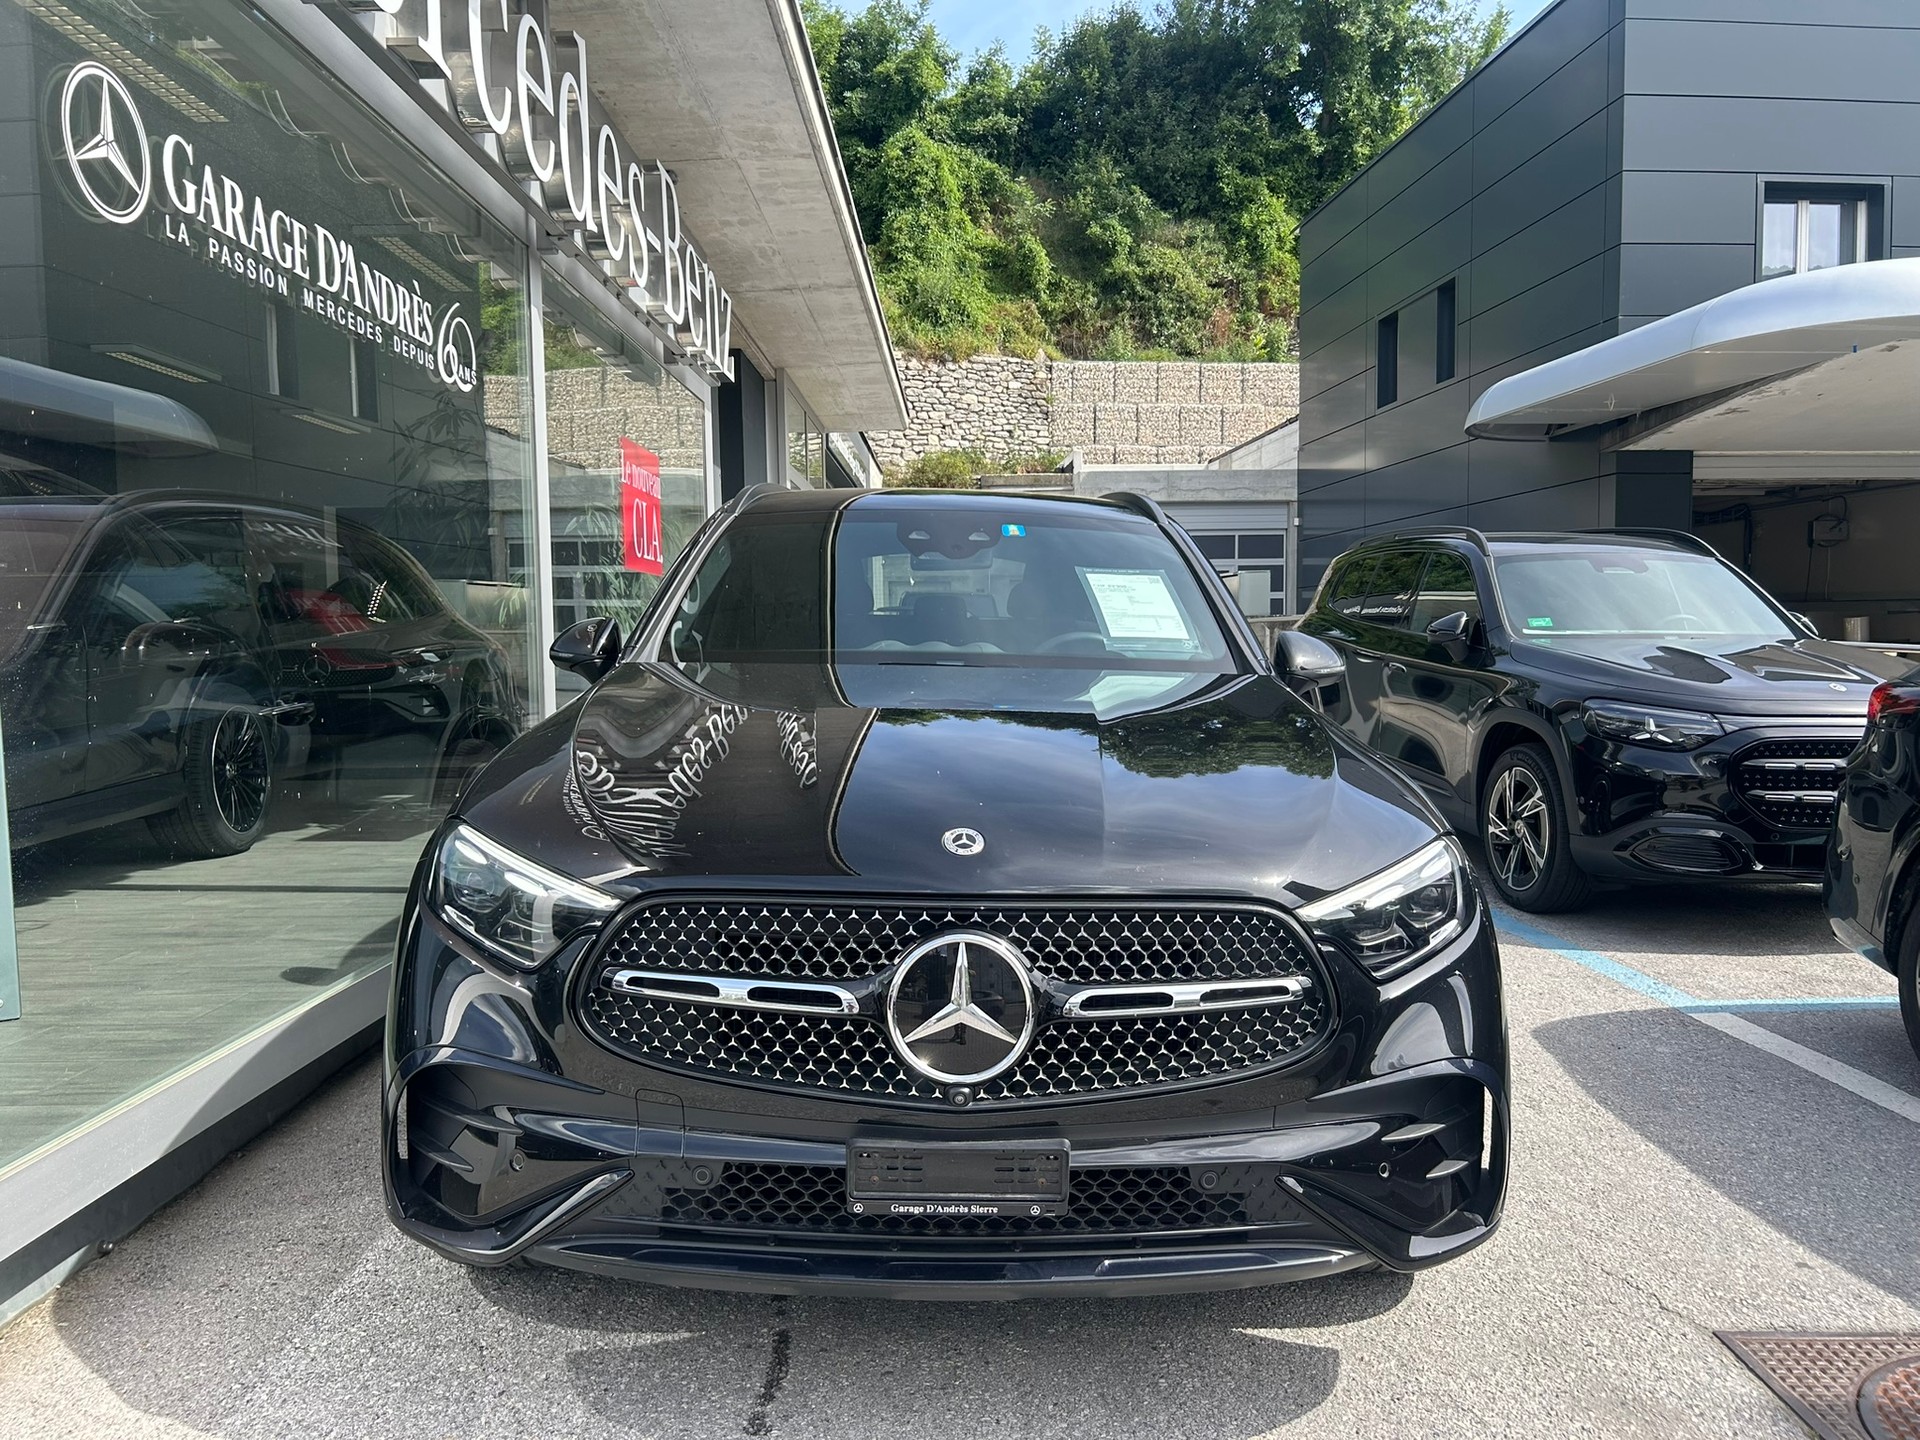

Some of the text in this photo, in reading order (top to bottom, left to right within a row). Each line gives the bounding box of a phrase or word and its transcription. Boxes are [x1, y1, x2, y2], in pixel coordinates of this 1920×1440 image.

[162, 134, 434, 347] GARAGE D'ANDRÈS
[373, 0, 735, 383] cedes-Benz
[165, 214, 190, 247] LA
[208, 238, 288, 297] PASSION
[303, 287, 383, 344] MERCEDES
[393, 335, 435, 370] DEPUIS
[458, 364, 478, 386] ANS
[632, 498, 663, 563] CLA
[890, 1203, 999, 1214] Garage D'Andrès Sierre
